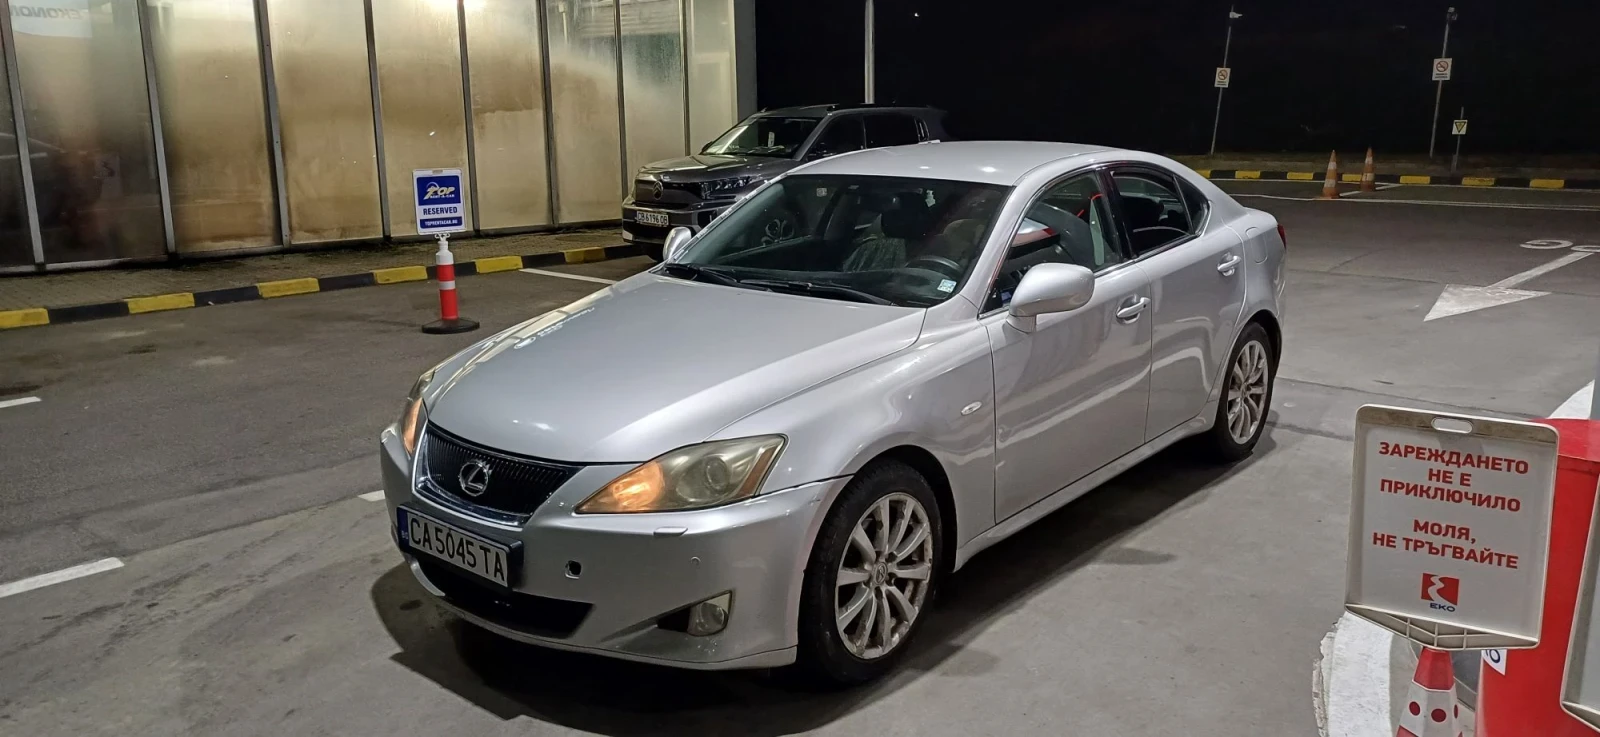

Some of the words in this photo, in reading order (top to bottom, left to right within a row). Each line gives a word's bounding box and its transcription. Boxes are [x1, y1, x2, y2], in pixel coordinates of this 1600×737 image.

[423, 186, 455, 200] TOP
[423, 206, 458, 216] RESERVED
[1379, 441, 1529, 475] ЗАРЕЖДАНЕТО
[1428, 468, 1454, 484] НЕ
[1459, 472, 1472, 487] Е
[1380, 479, 1521, 512] ПРИКЛЮЧИЛО
[1413, 519, 1476, 544] МОЛЯ,
[410, 518, 433, 551] CA
[434, 527, 477, 568] 5045
[479, 544, 506, 582] TA
[1372, 532, 1397, 548] НЕ
[1402, 537, 1519, 569] ТРЪГВАЙТЕ
[1429, 602, 1456, 613] EKO
